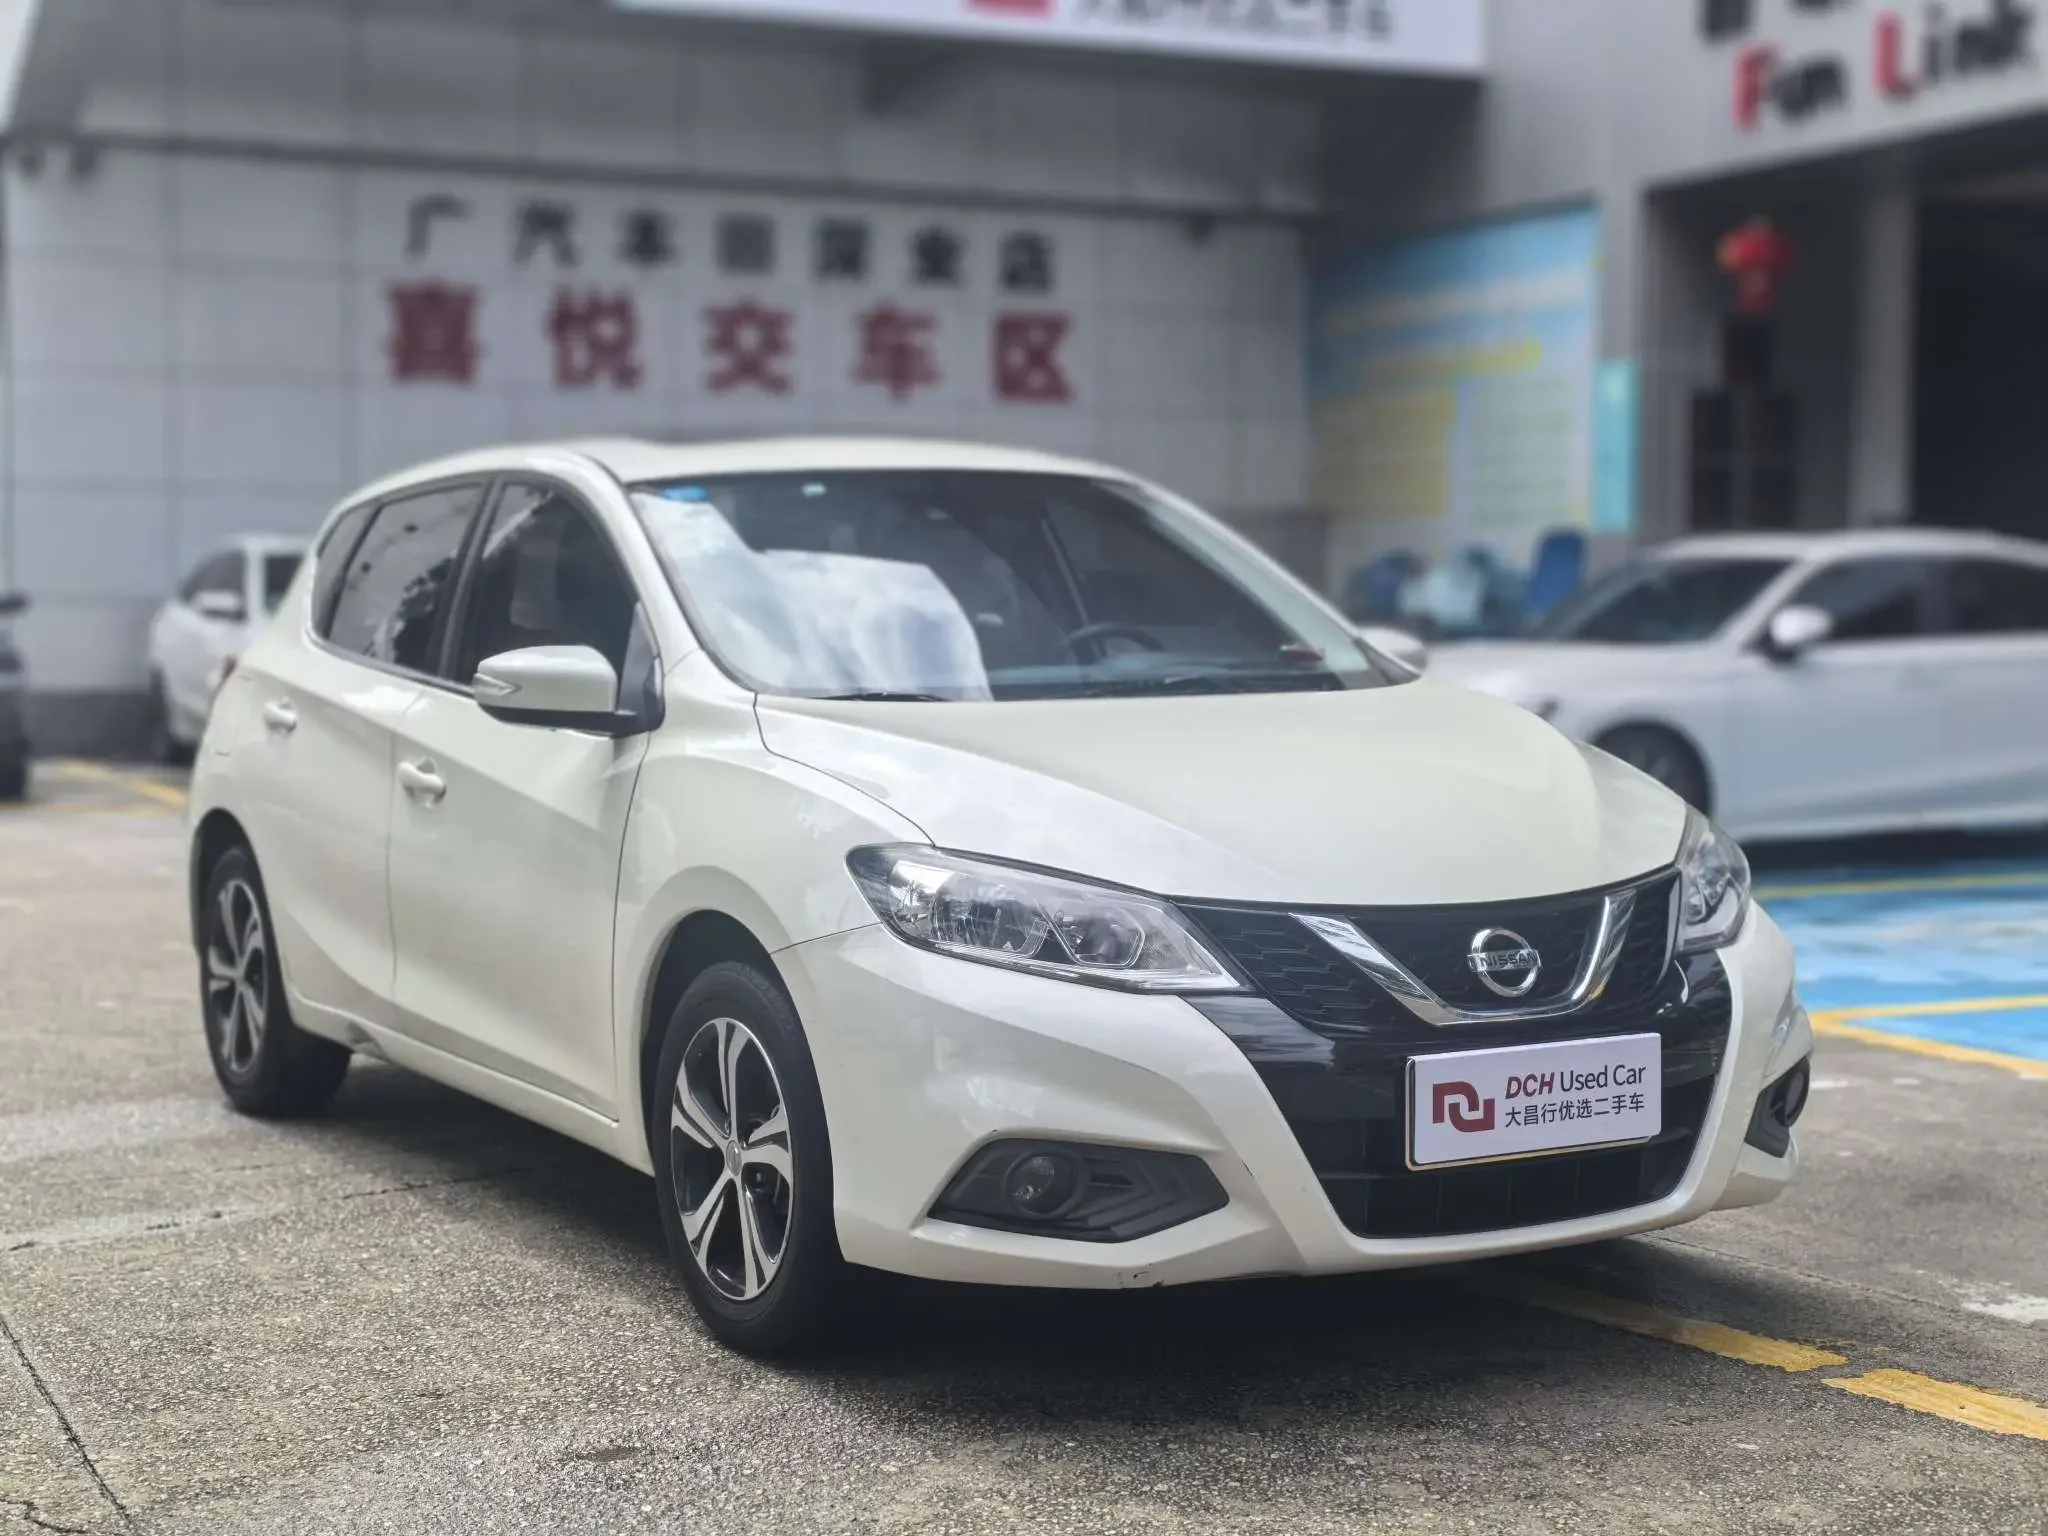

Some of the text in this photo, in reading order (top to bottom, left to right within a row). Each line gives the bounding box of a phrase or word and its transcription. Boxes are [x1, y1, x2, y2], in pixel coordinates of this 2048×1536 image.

[1479, 949, 1538, 970] NISSAN
[1505, 1064, 1646, 1099] DCH Used Car
[1505, 1092, 1645, 1128] 大昌行优选二手车
